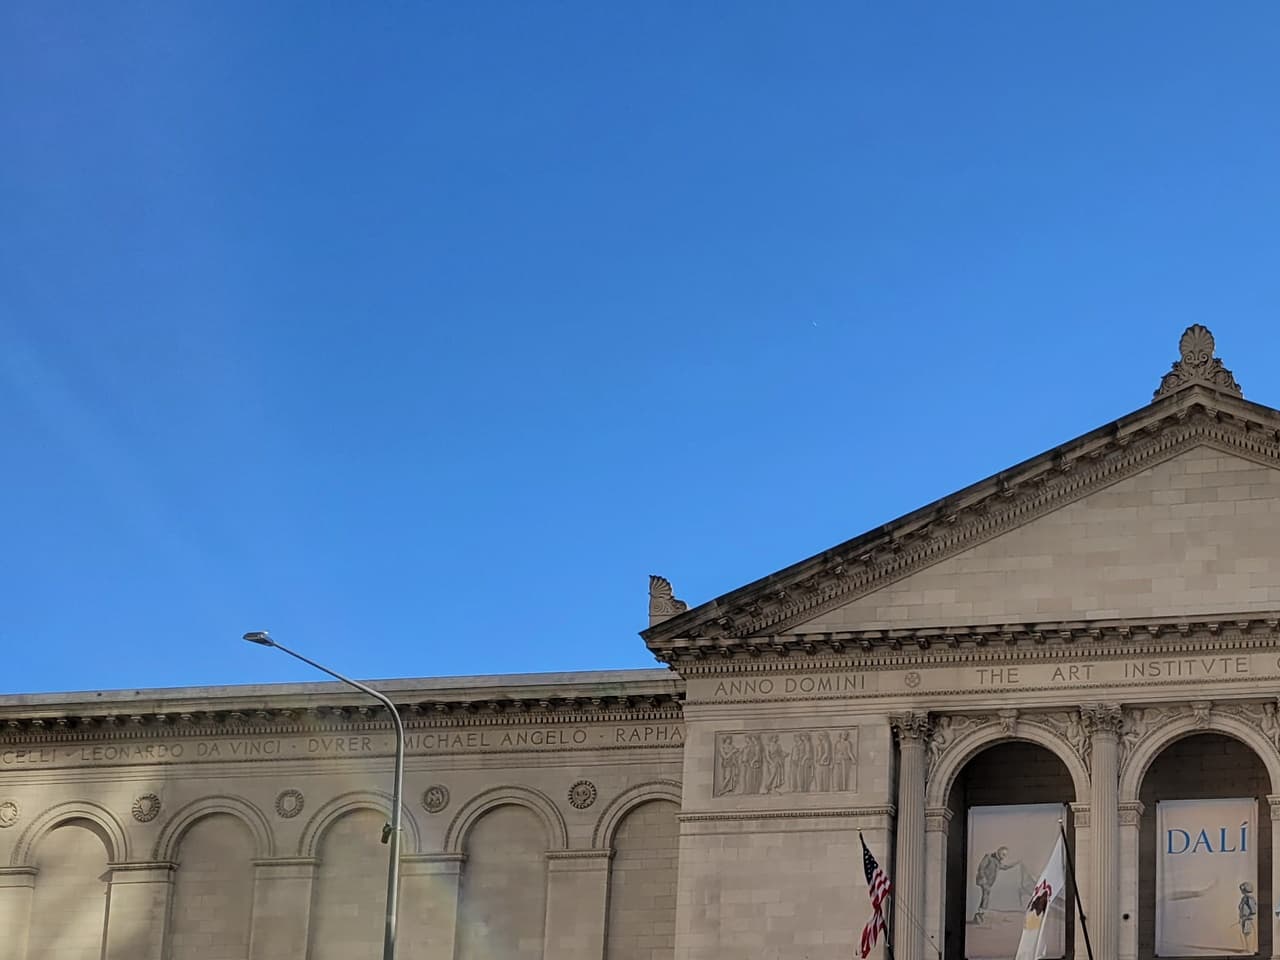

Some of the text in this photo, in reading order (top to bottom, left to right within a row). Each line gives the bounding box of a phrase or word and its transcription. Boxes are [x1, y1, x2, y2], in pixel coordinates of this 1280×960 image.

[714, 678, 774, 697] ANNO
[785, 674, 865, 694] DOMINI
[976, 667, 1020, 685] THE
[1051, 664, 1095, 682] ART
[1124, 656, 1248, 679] INSTITVTE
[3, 749, 56, 765] CELLI
[80, 743, 184, 761] LEONARDO
[197, 743, 221, 757] DA
[229, 740, 281, 755] VINCI
[308, 737, 372, 753] DVRER
[500, 729, 587, 746] ANGELO
[615, 727, 683, 743] RAPHA
[1167, 821, 1249, 855] DALÍ
